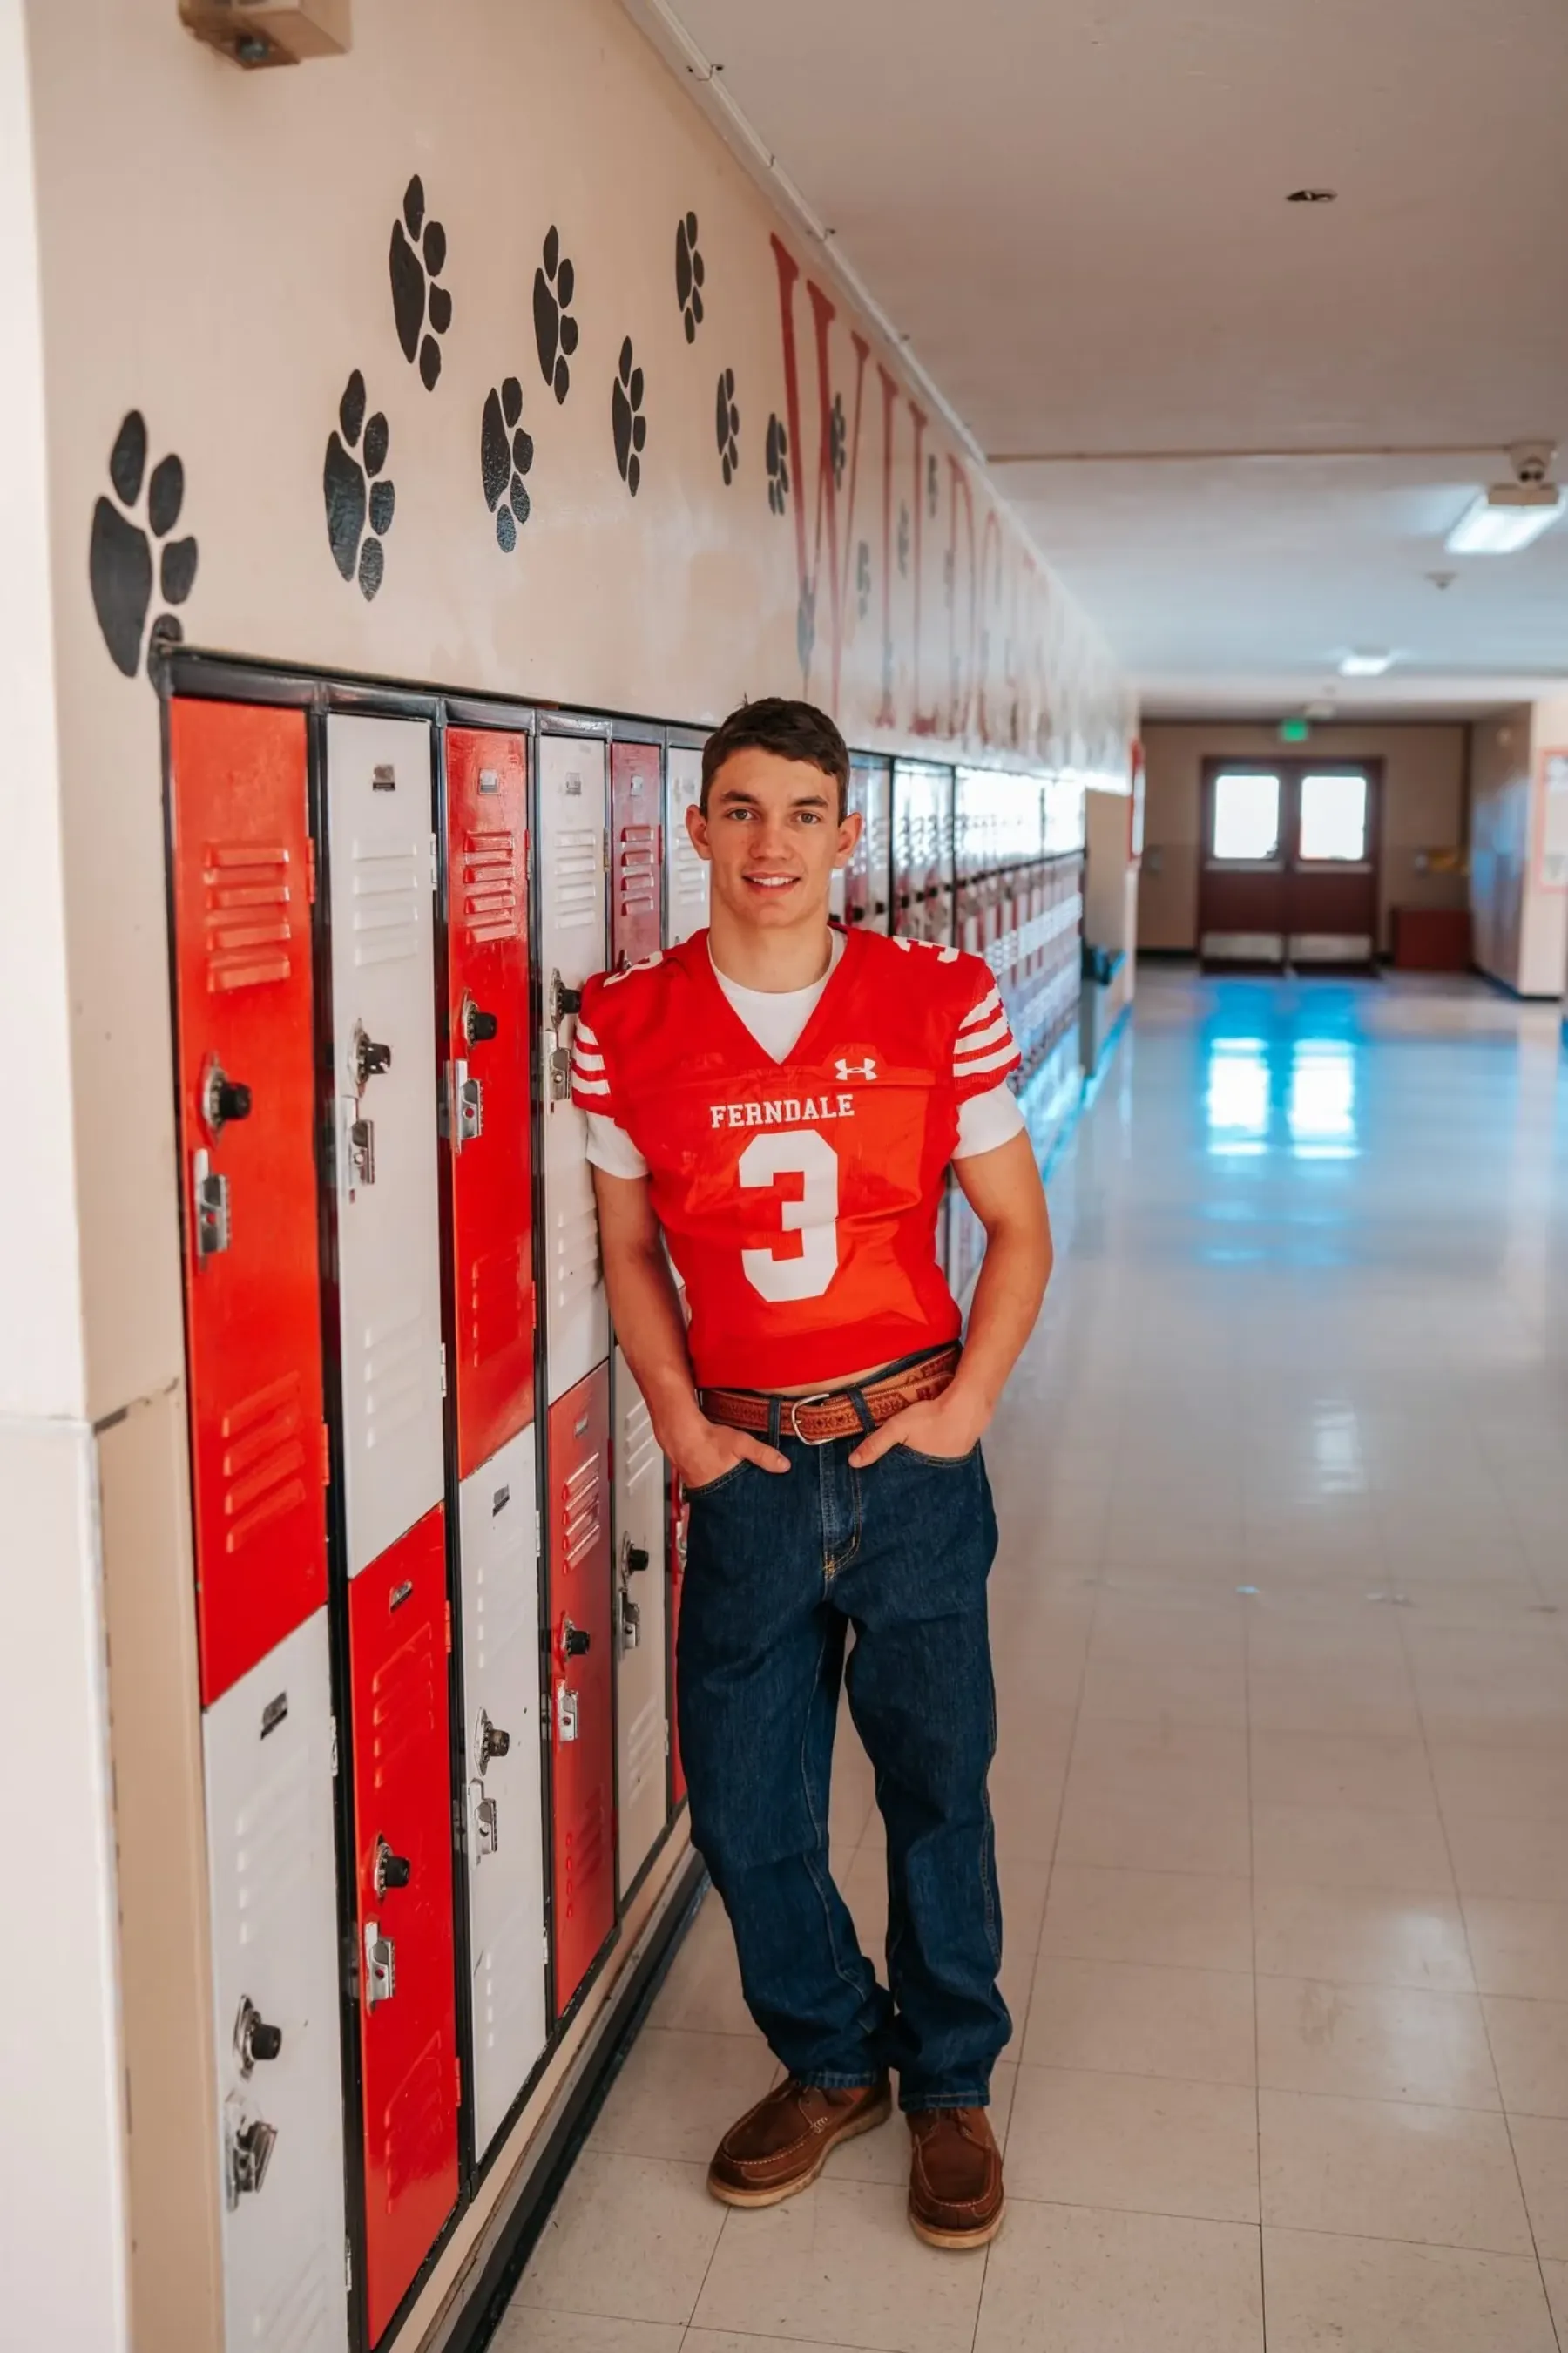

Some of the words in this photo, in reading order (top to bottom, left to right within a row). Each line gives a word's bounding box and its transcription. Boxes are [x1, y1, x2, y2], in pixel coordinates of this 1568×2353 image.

[770, 231, 1052, 756] WILDC
[710, 1094, 855, 1128] FERNDALE
[739, 1129, 839, 1302] 3
